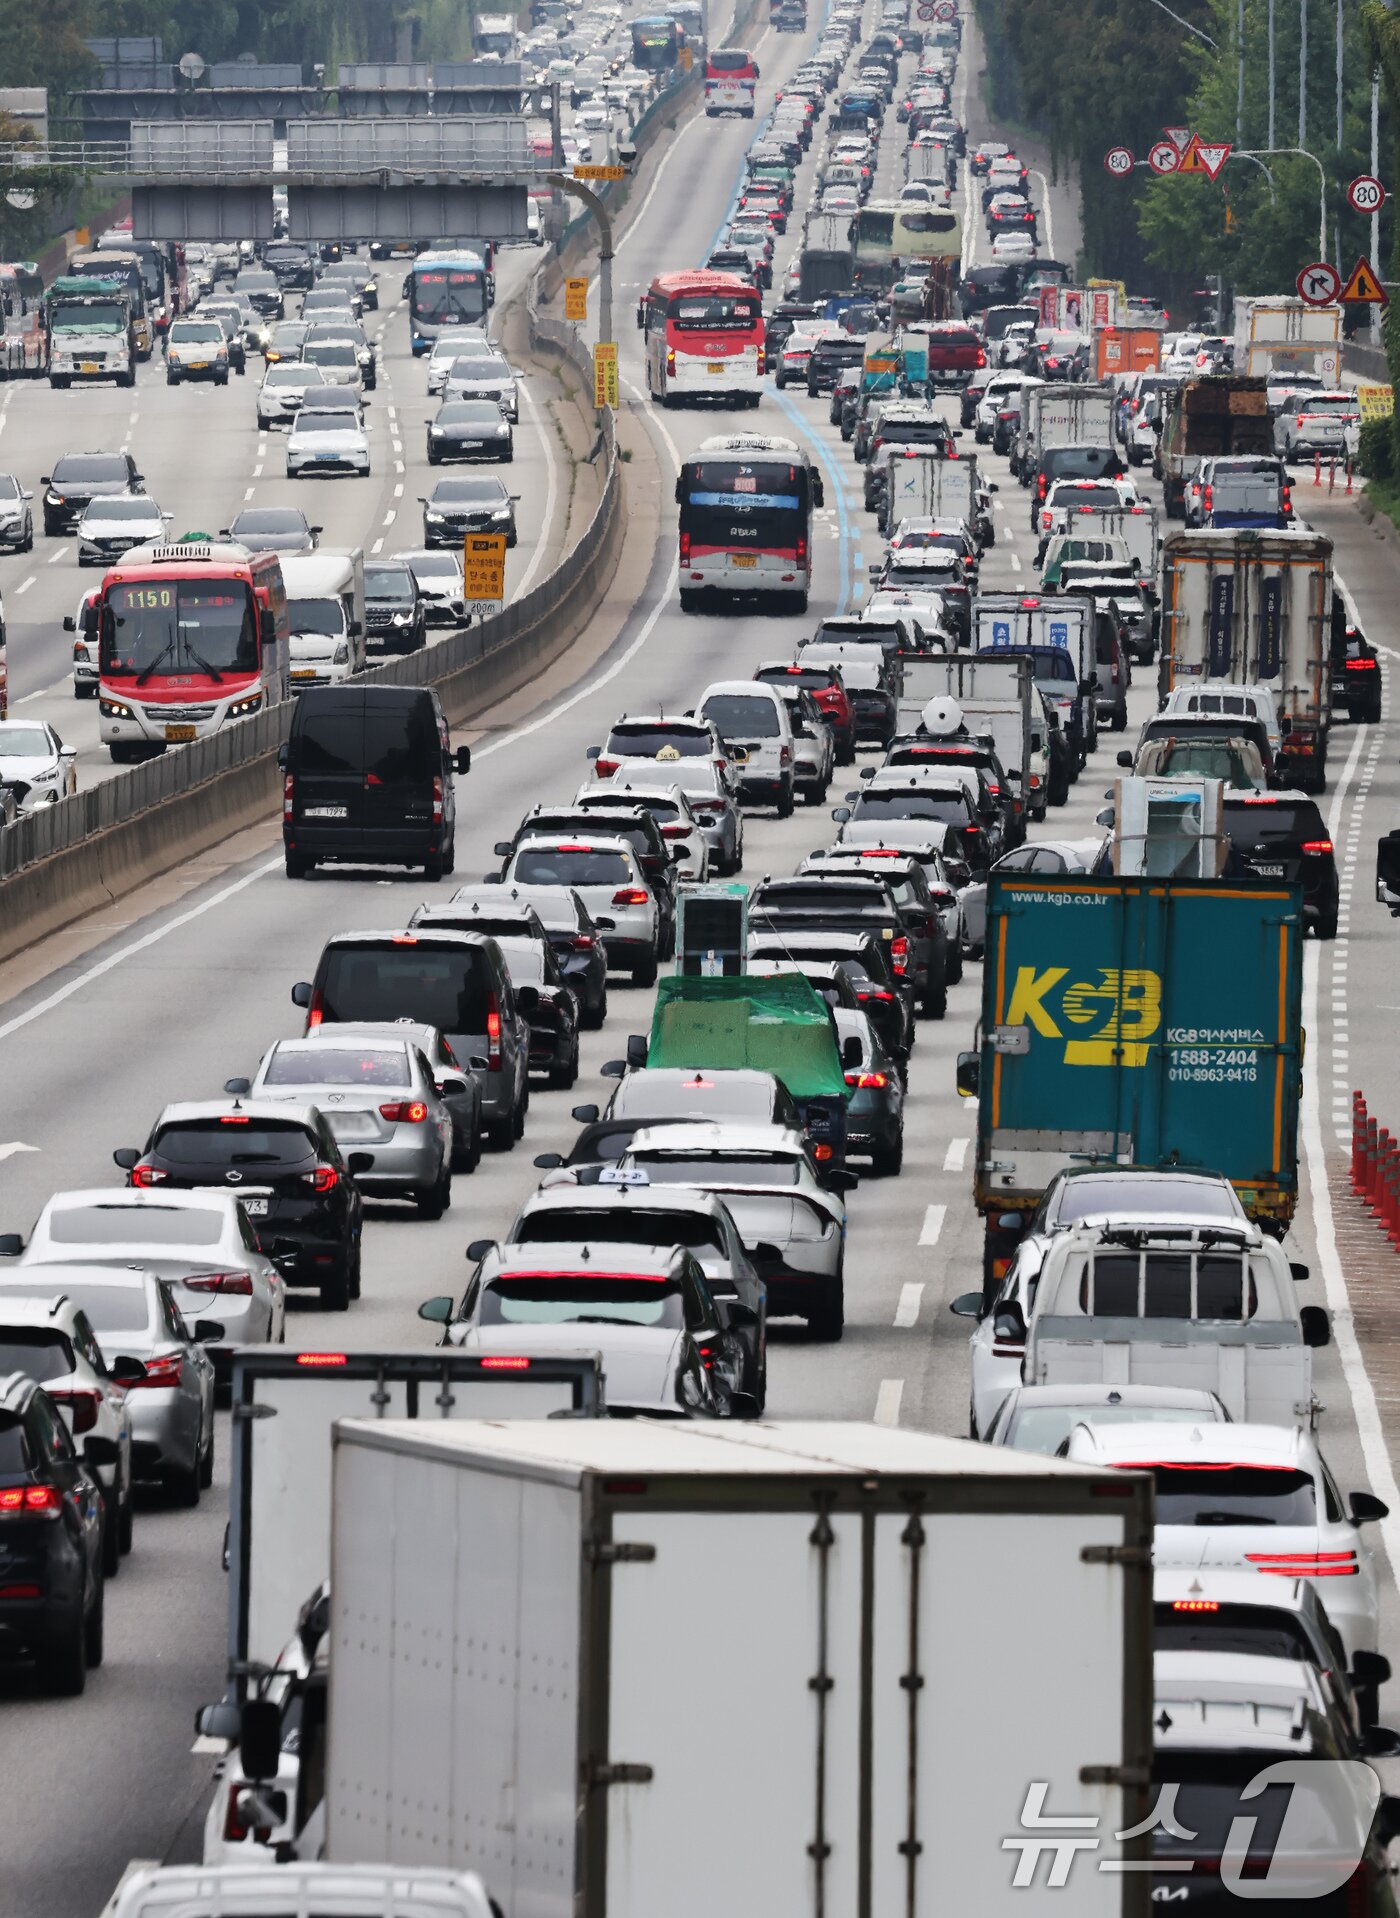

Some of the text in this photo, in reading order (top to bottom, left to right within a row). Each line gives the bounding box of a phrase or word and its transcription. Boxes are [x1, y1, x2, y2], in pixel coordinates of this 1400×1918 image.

[1111, 154, 1128, 169] 80
[1357, 186, 1378, 203] 80
[127, 591, 170, 608] 1150
[471, 602, 495, 614] 200m
[1011, 891, 1108, 906] www.kgb.co.kr
[1005, 966, 1161, 1039] KGB
[1171, 1050, 1258, 1065] 1588-2404
[1168, 1068, 1257, 1082] 010-8963-9418
